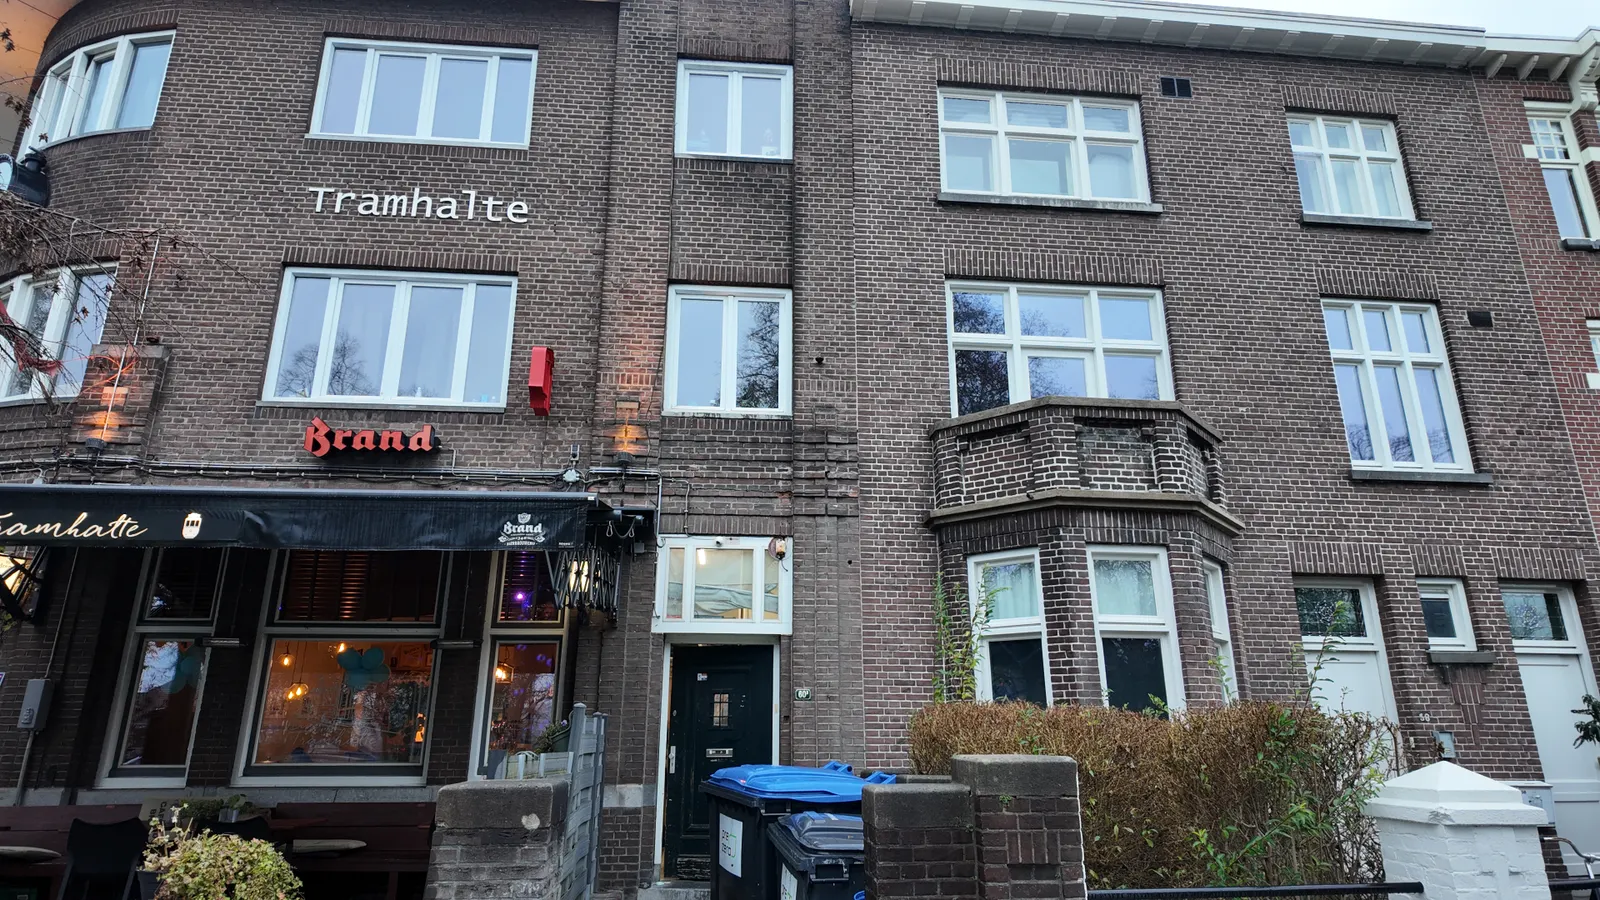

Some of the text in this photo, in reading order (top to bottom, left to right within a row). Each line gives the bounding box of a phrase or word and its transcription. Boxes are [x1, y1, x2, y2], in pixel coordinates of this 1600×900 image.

[309, 187, 529, 223] Tramhalte
[304, 416, 434, 457] Brand
[0, 511, 148, 538] amhalte
[503, 521, 542, 534] Brand
